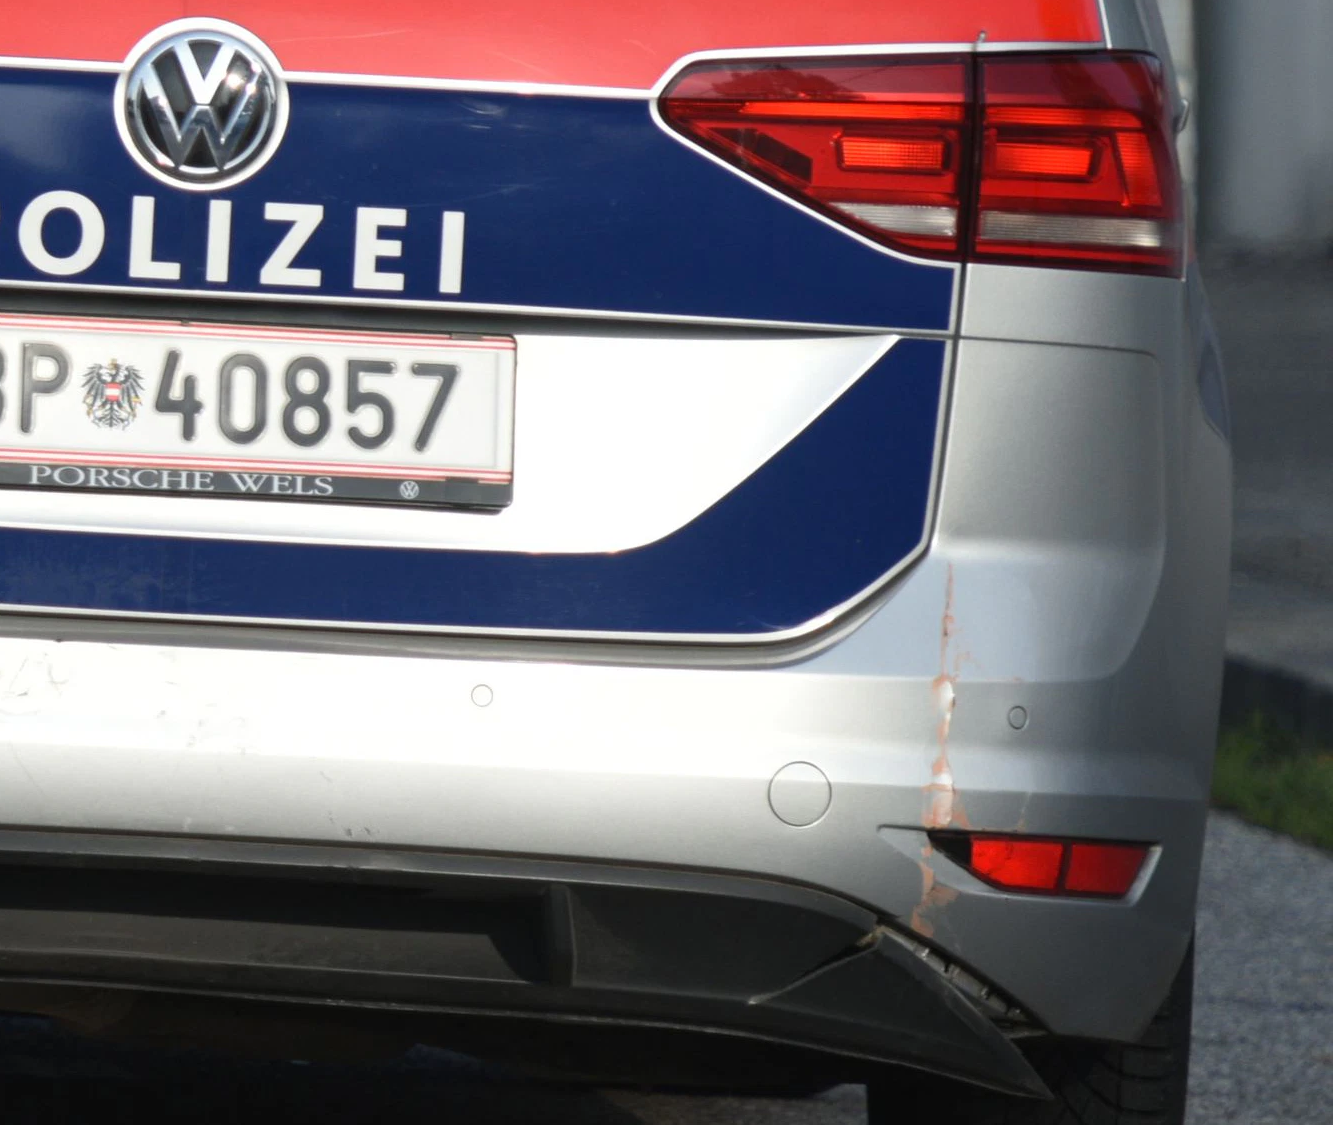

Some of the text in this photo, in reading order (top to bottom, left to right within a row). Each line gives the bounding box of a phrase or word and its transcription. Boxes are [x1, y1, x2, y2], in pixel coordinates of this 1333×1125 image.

[153, 347, 463, 453] 40857
[29, 464, 215, 492] PORSCHE
[229, 472, 334, 496] WELS
